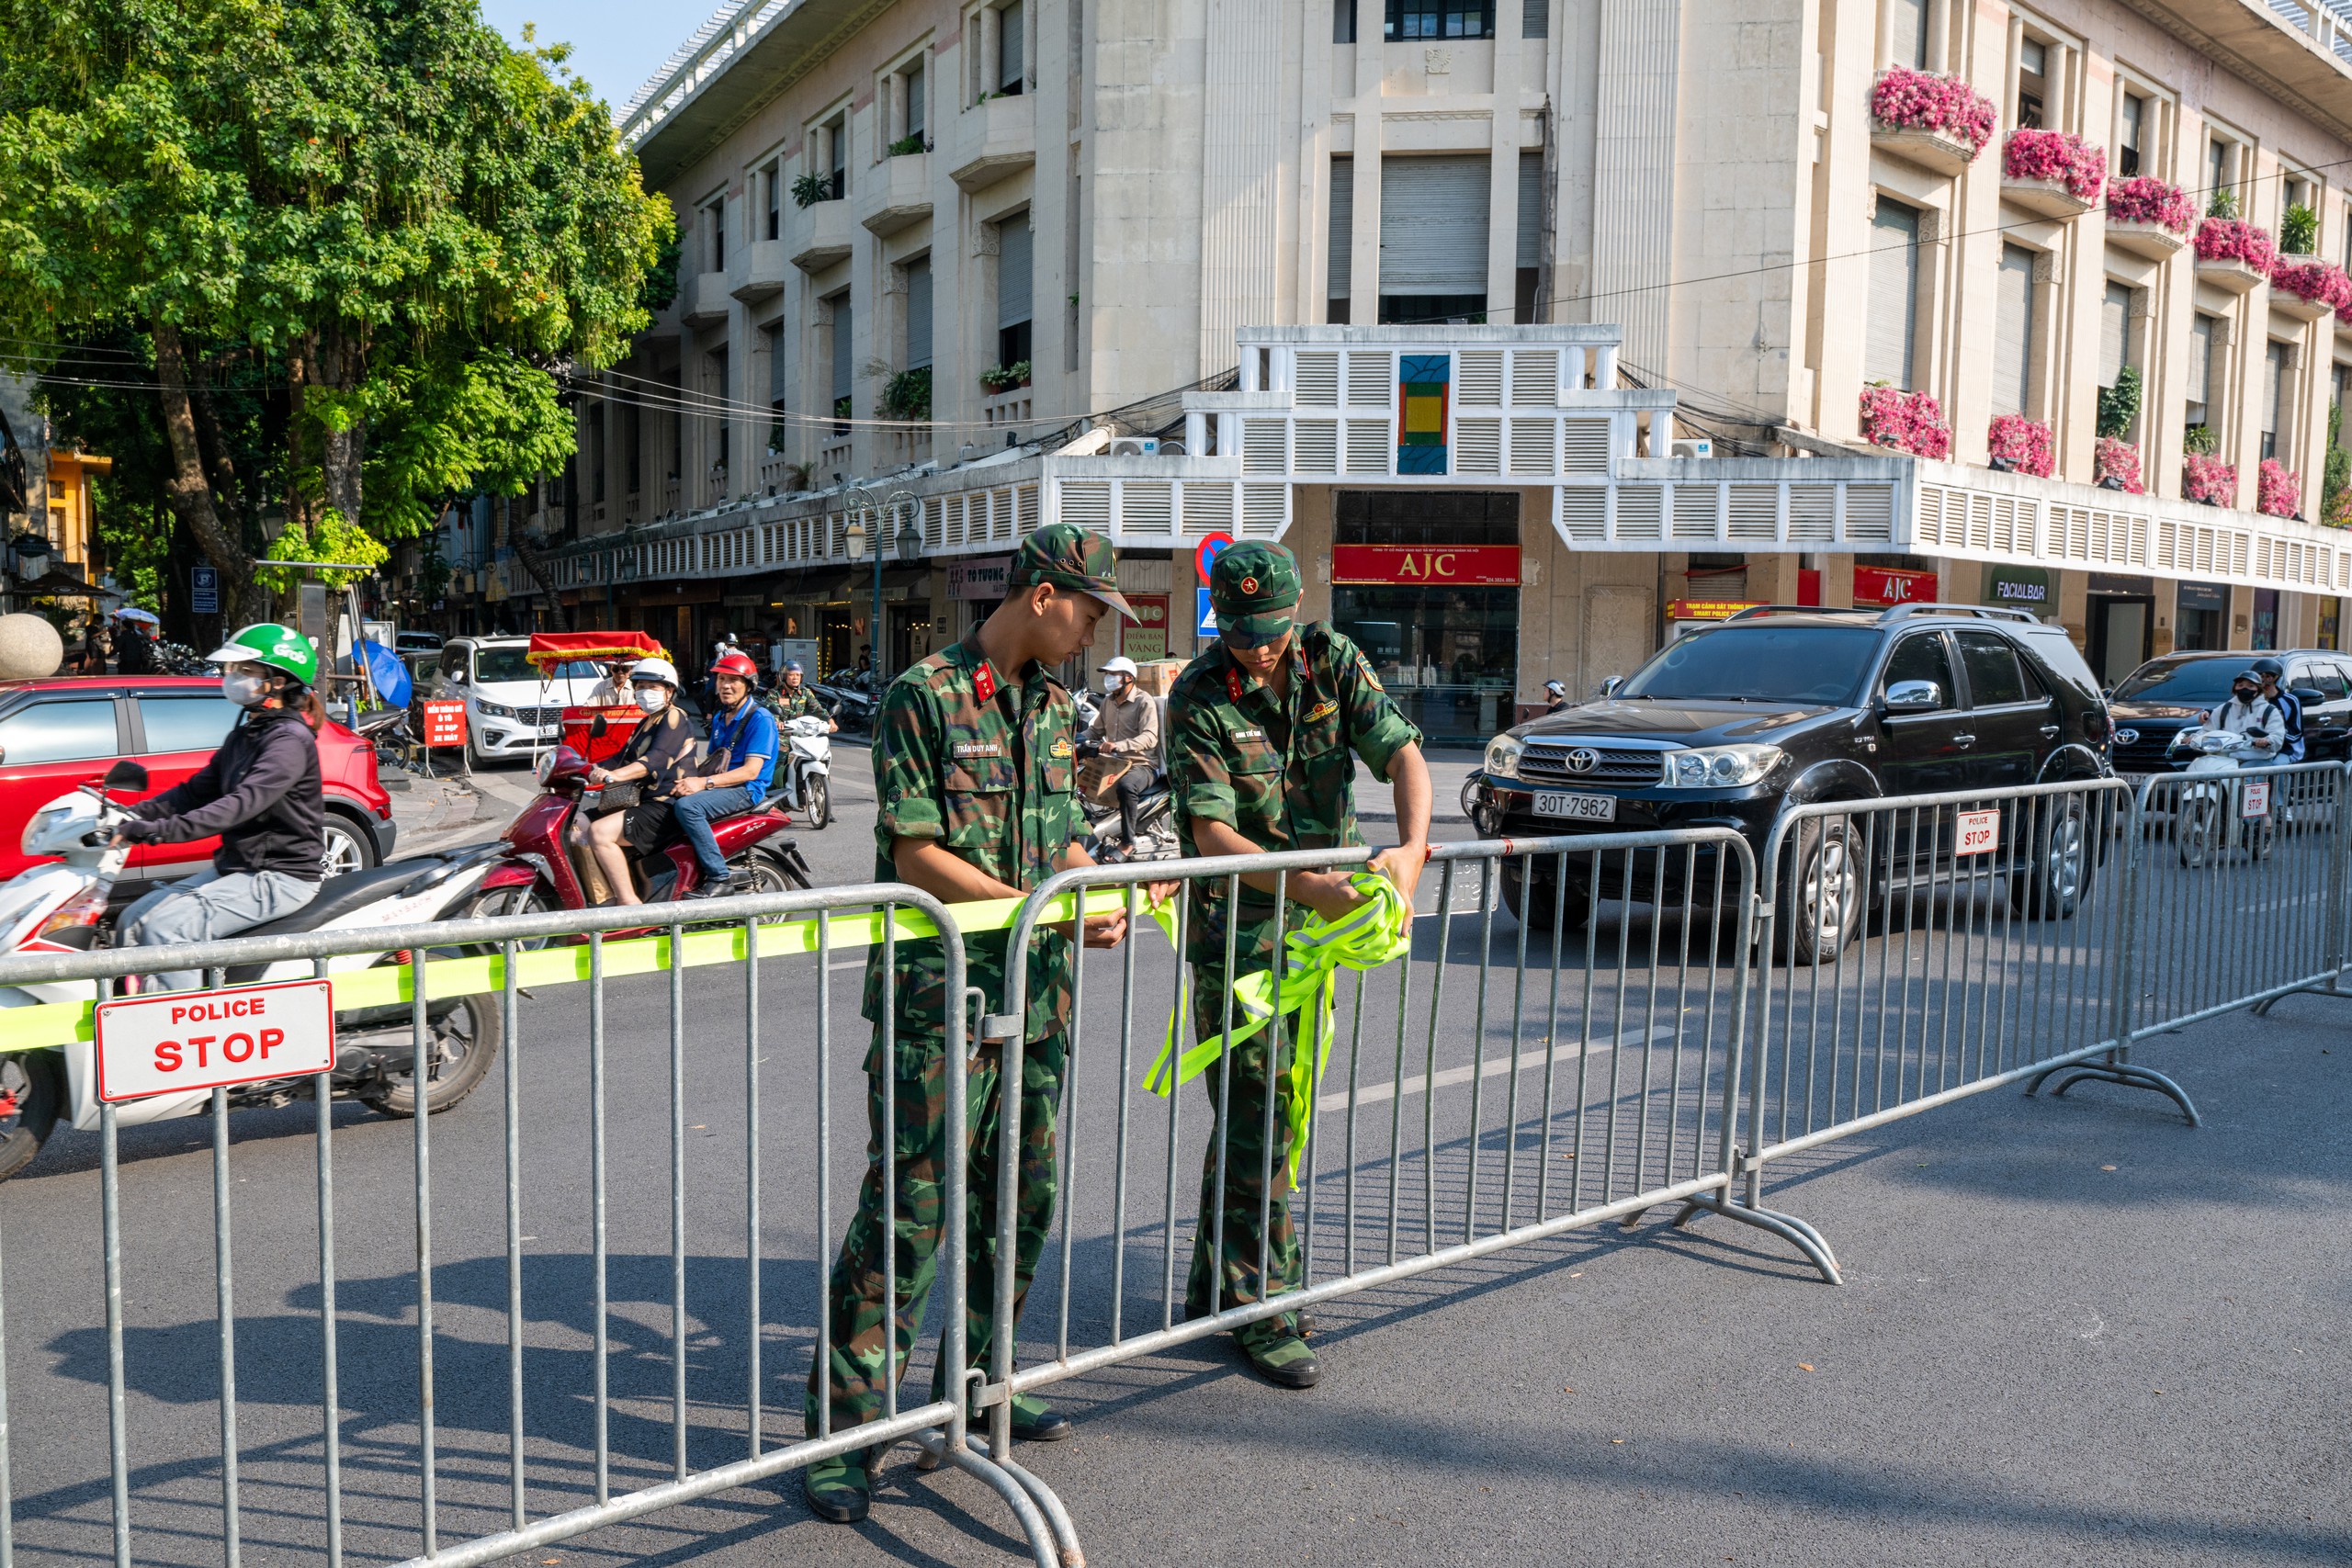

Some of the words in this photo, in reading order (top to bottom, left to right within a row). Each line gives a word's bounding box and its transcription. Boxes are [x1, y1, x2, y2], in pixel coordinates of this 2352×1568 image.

[1396, 553, 1455, 581] AJC
[1883, 577, 1912, 602] AJC
[272, 643, 308, 665] Grab
[1128, 641, 1161, 653] VÀNG
[444, 714, 453, 722] TÔ
[444, 733, 458, 741] MÁY
[2248, 798, 2262, 810] STOP
[1969, 817, 1988, 825] POLICE
[1964, 830, 1990, 845] STOP
[172, 997, 266, 1025] POLICE
[153, 1028, 285, 1072] STOP
